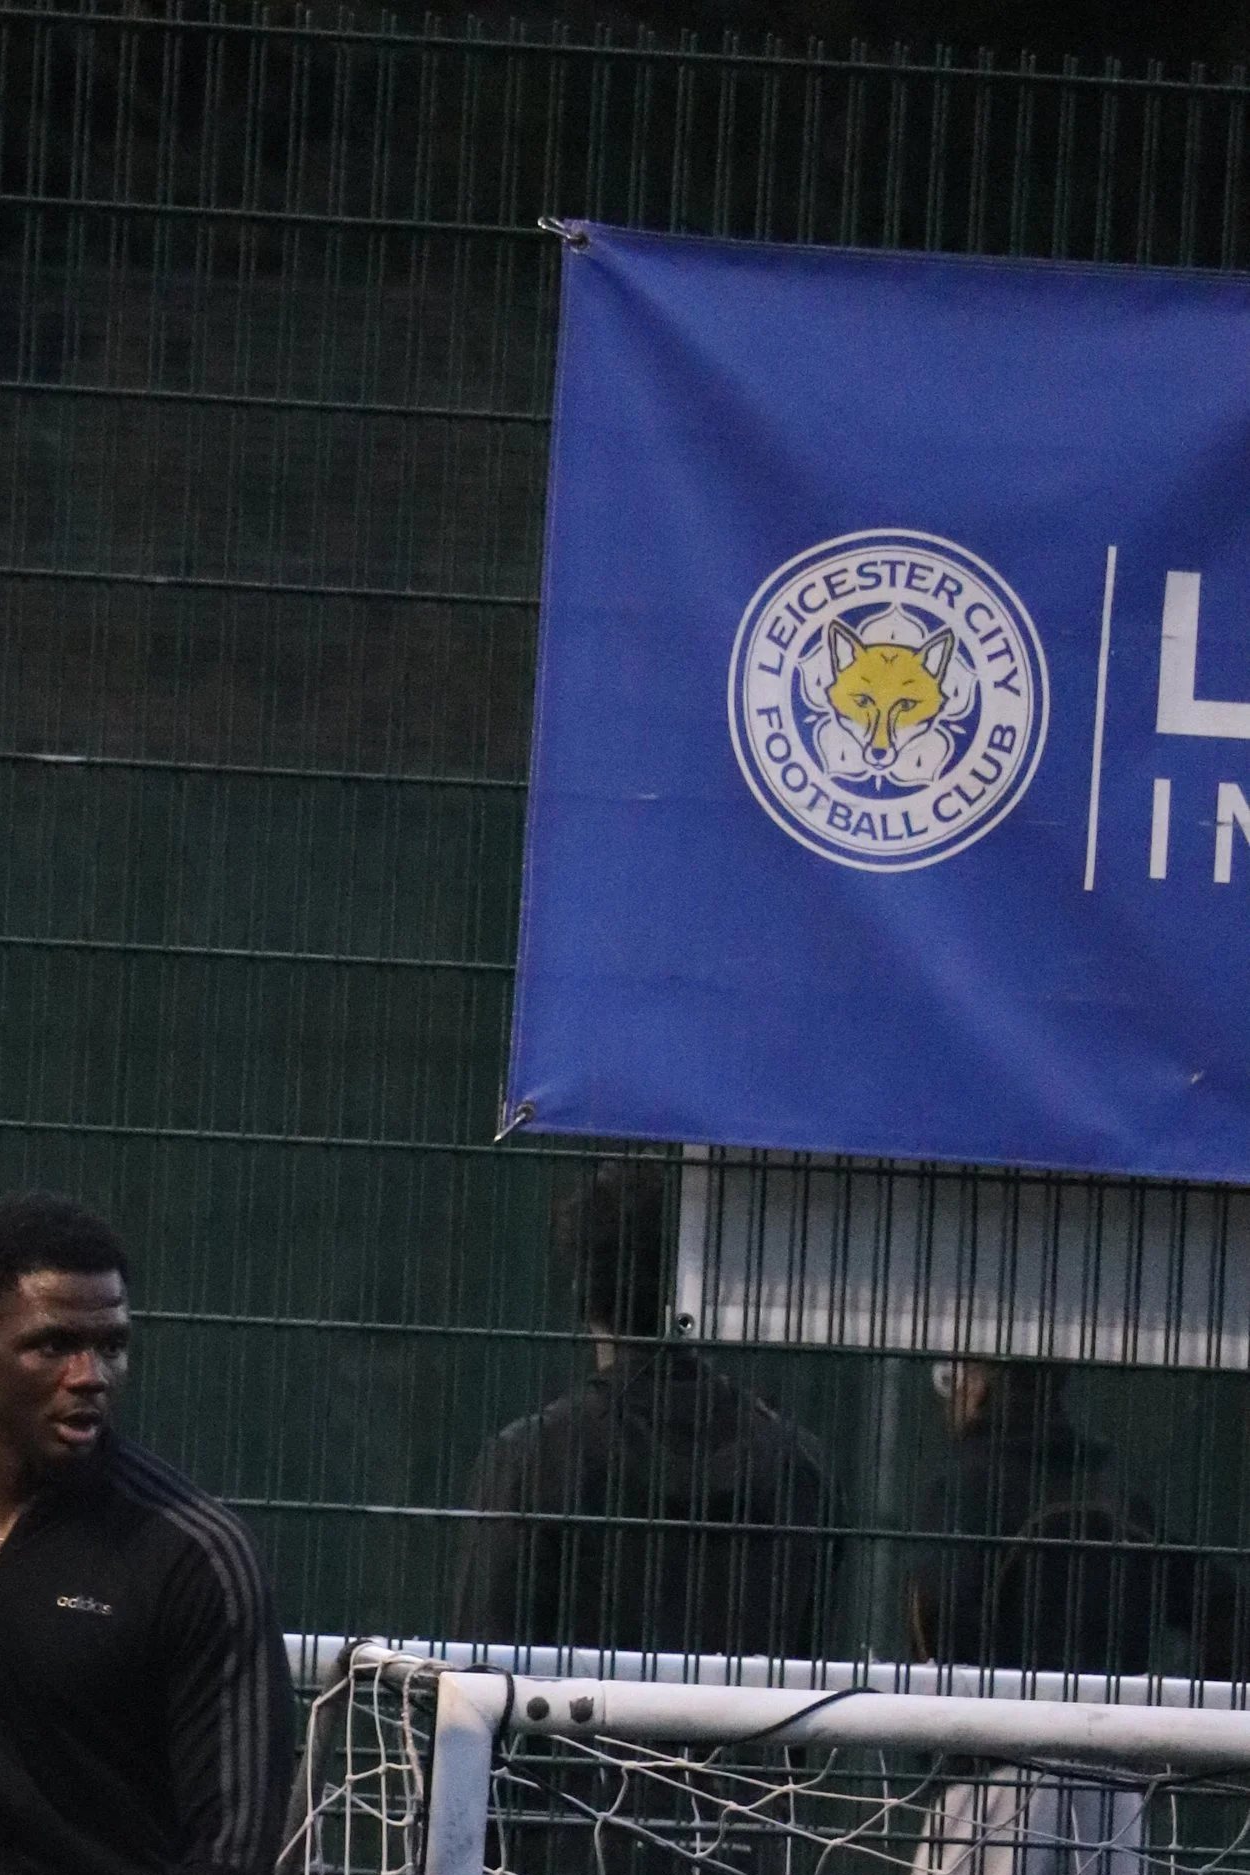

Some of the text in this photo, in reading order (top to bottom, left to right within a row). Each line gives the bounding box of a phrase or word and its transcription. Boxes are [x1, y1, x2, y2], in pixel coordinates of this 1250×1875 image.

[758, 559, 1021, 697] LEICESTER CITY
[756, 706, 1017, 842] FOOTBALL CLUB
